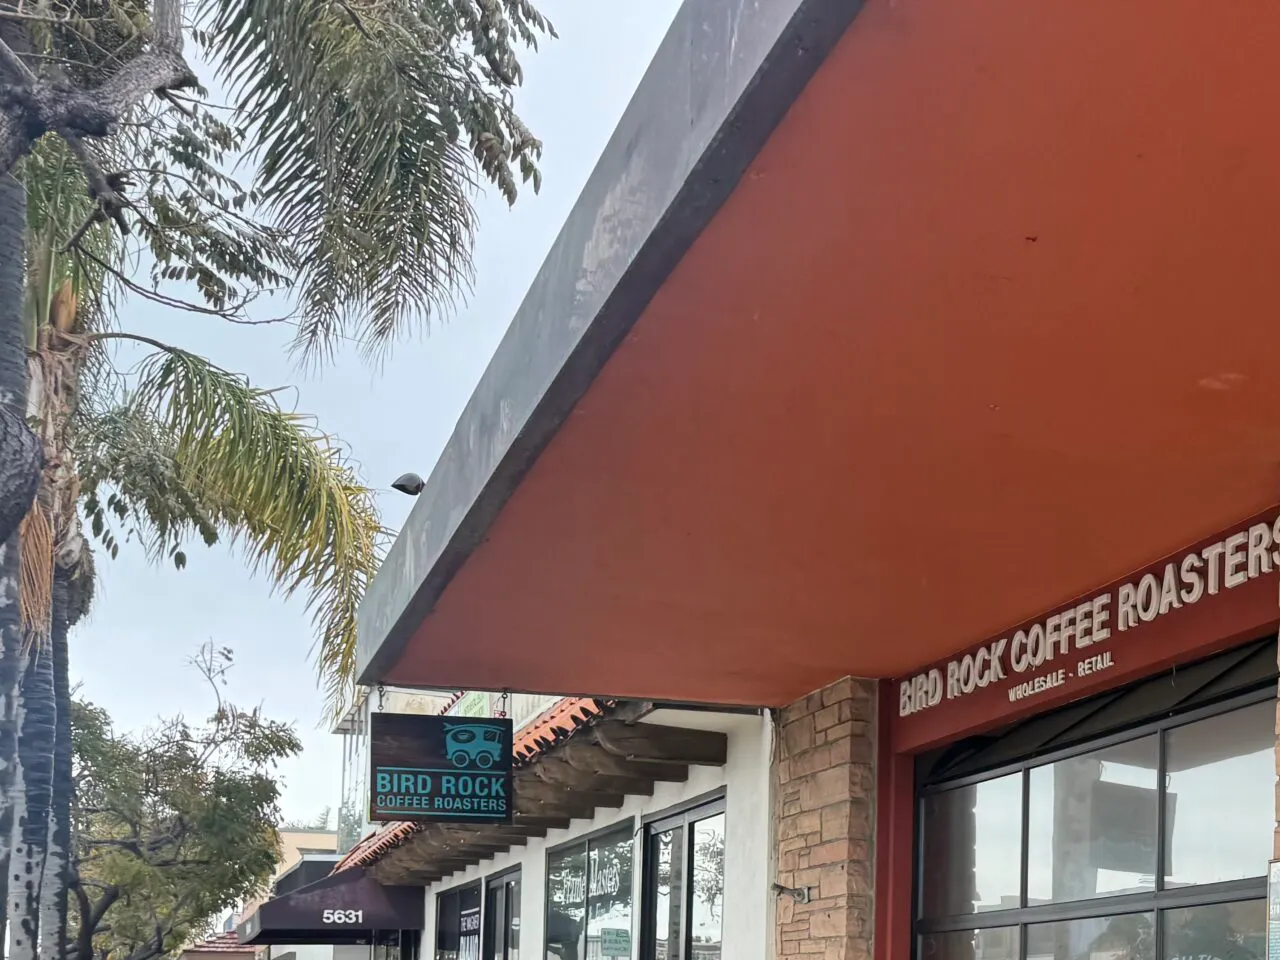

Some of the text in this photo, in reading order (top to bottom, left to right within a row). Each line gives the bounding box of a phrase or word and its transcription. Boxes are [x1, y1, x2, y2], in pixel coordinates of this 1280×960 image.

[898, 667, 944, 718] BIRD
[946, 638, 1008, 700] ROCK
[1010, 592, 1112, 673] COFFEE
[1008, 670, 1066, 702] WHOLESALE
[1077, 652, 1114, 678] RETAIL
[376, 772, 506, 797] BIRD ROCK
[376, 794, 507, 812] COFFEE ROASTERS
[322, 909, 363, 924] 5631
